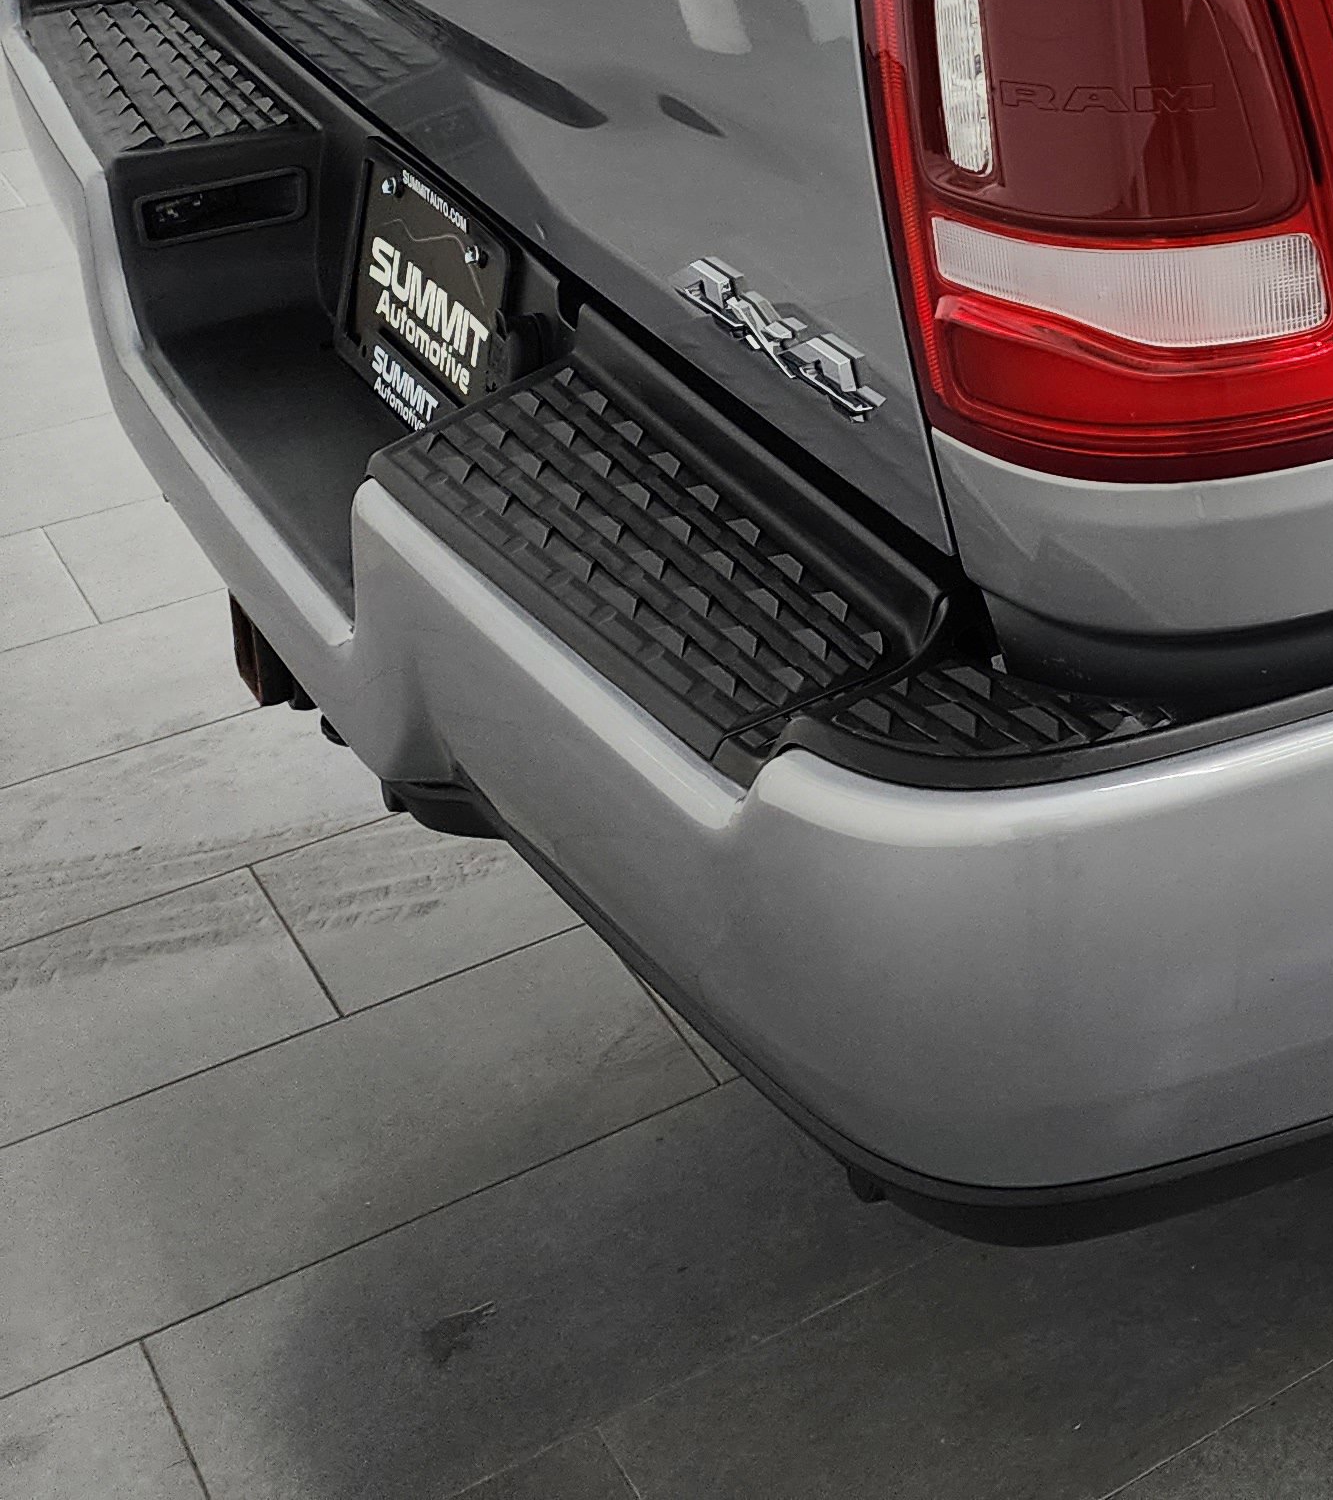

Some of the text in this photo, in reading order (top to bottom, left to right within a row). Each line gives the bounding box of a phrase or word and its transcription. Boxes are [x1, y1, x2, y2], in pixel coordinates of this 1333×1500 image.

[999, 79, 1218, 114] RAM
[402, 169, 468, 234] SUMMITAUTO.COM
[368, 236, 489, 368] SUMMIT
[375, 289, 471, 395] Automotive
[371, 345, 440, 423] SUMMIT
